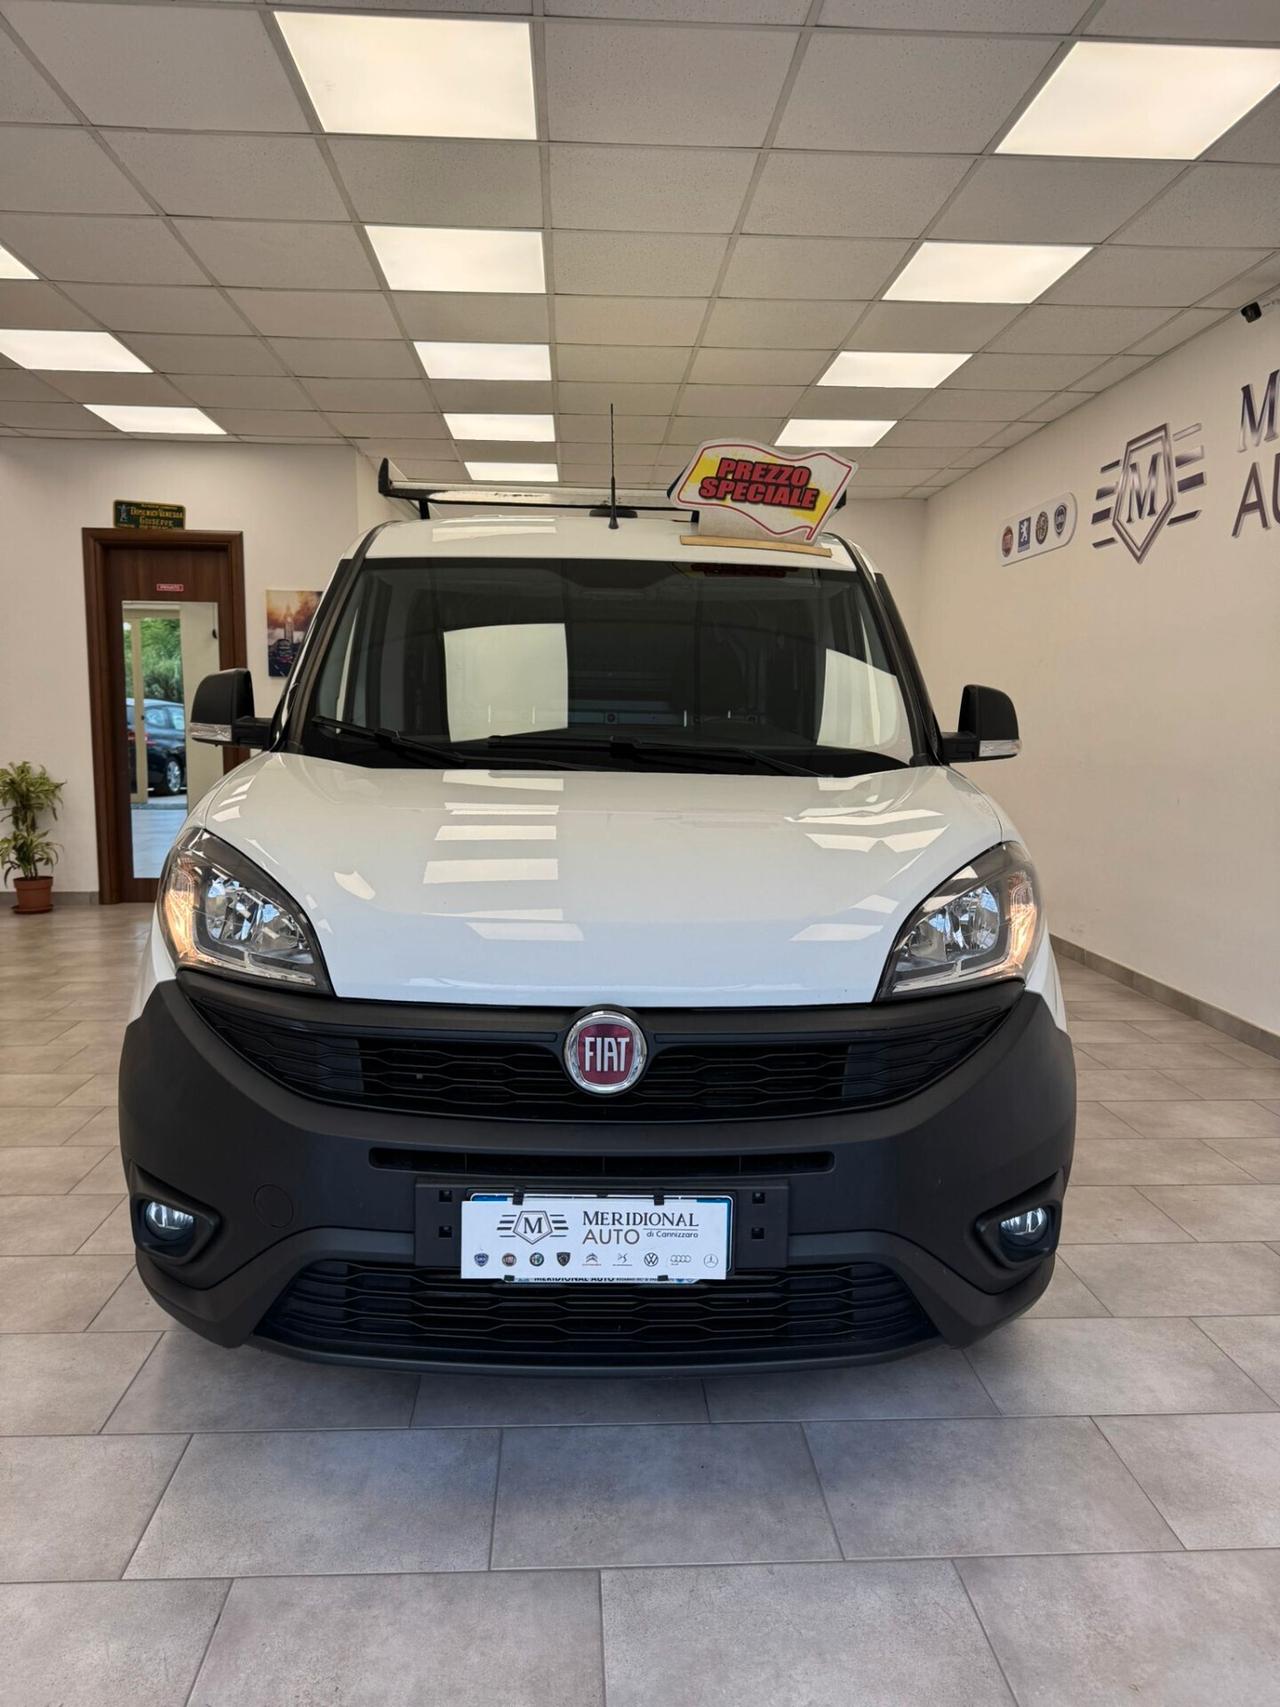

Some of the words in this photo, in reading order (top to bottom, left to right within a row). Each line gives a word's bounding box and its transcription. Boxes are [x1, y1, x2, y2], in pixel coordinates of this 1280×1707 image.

[716, 457, 811, 487] PREZZO
[699, 476, 820, 510] SPECIALE
[1126, 451, 1163, 524] M
[584, 1037, 630, 1072] FIAT
[523, 1217, 543, 1234] M
[582, 1210, 699, 1227] MERIDIONAL
[582, 1228, 640, 1245] AUTO
[656, 1231, 699, 1239] Cannizzaro
